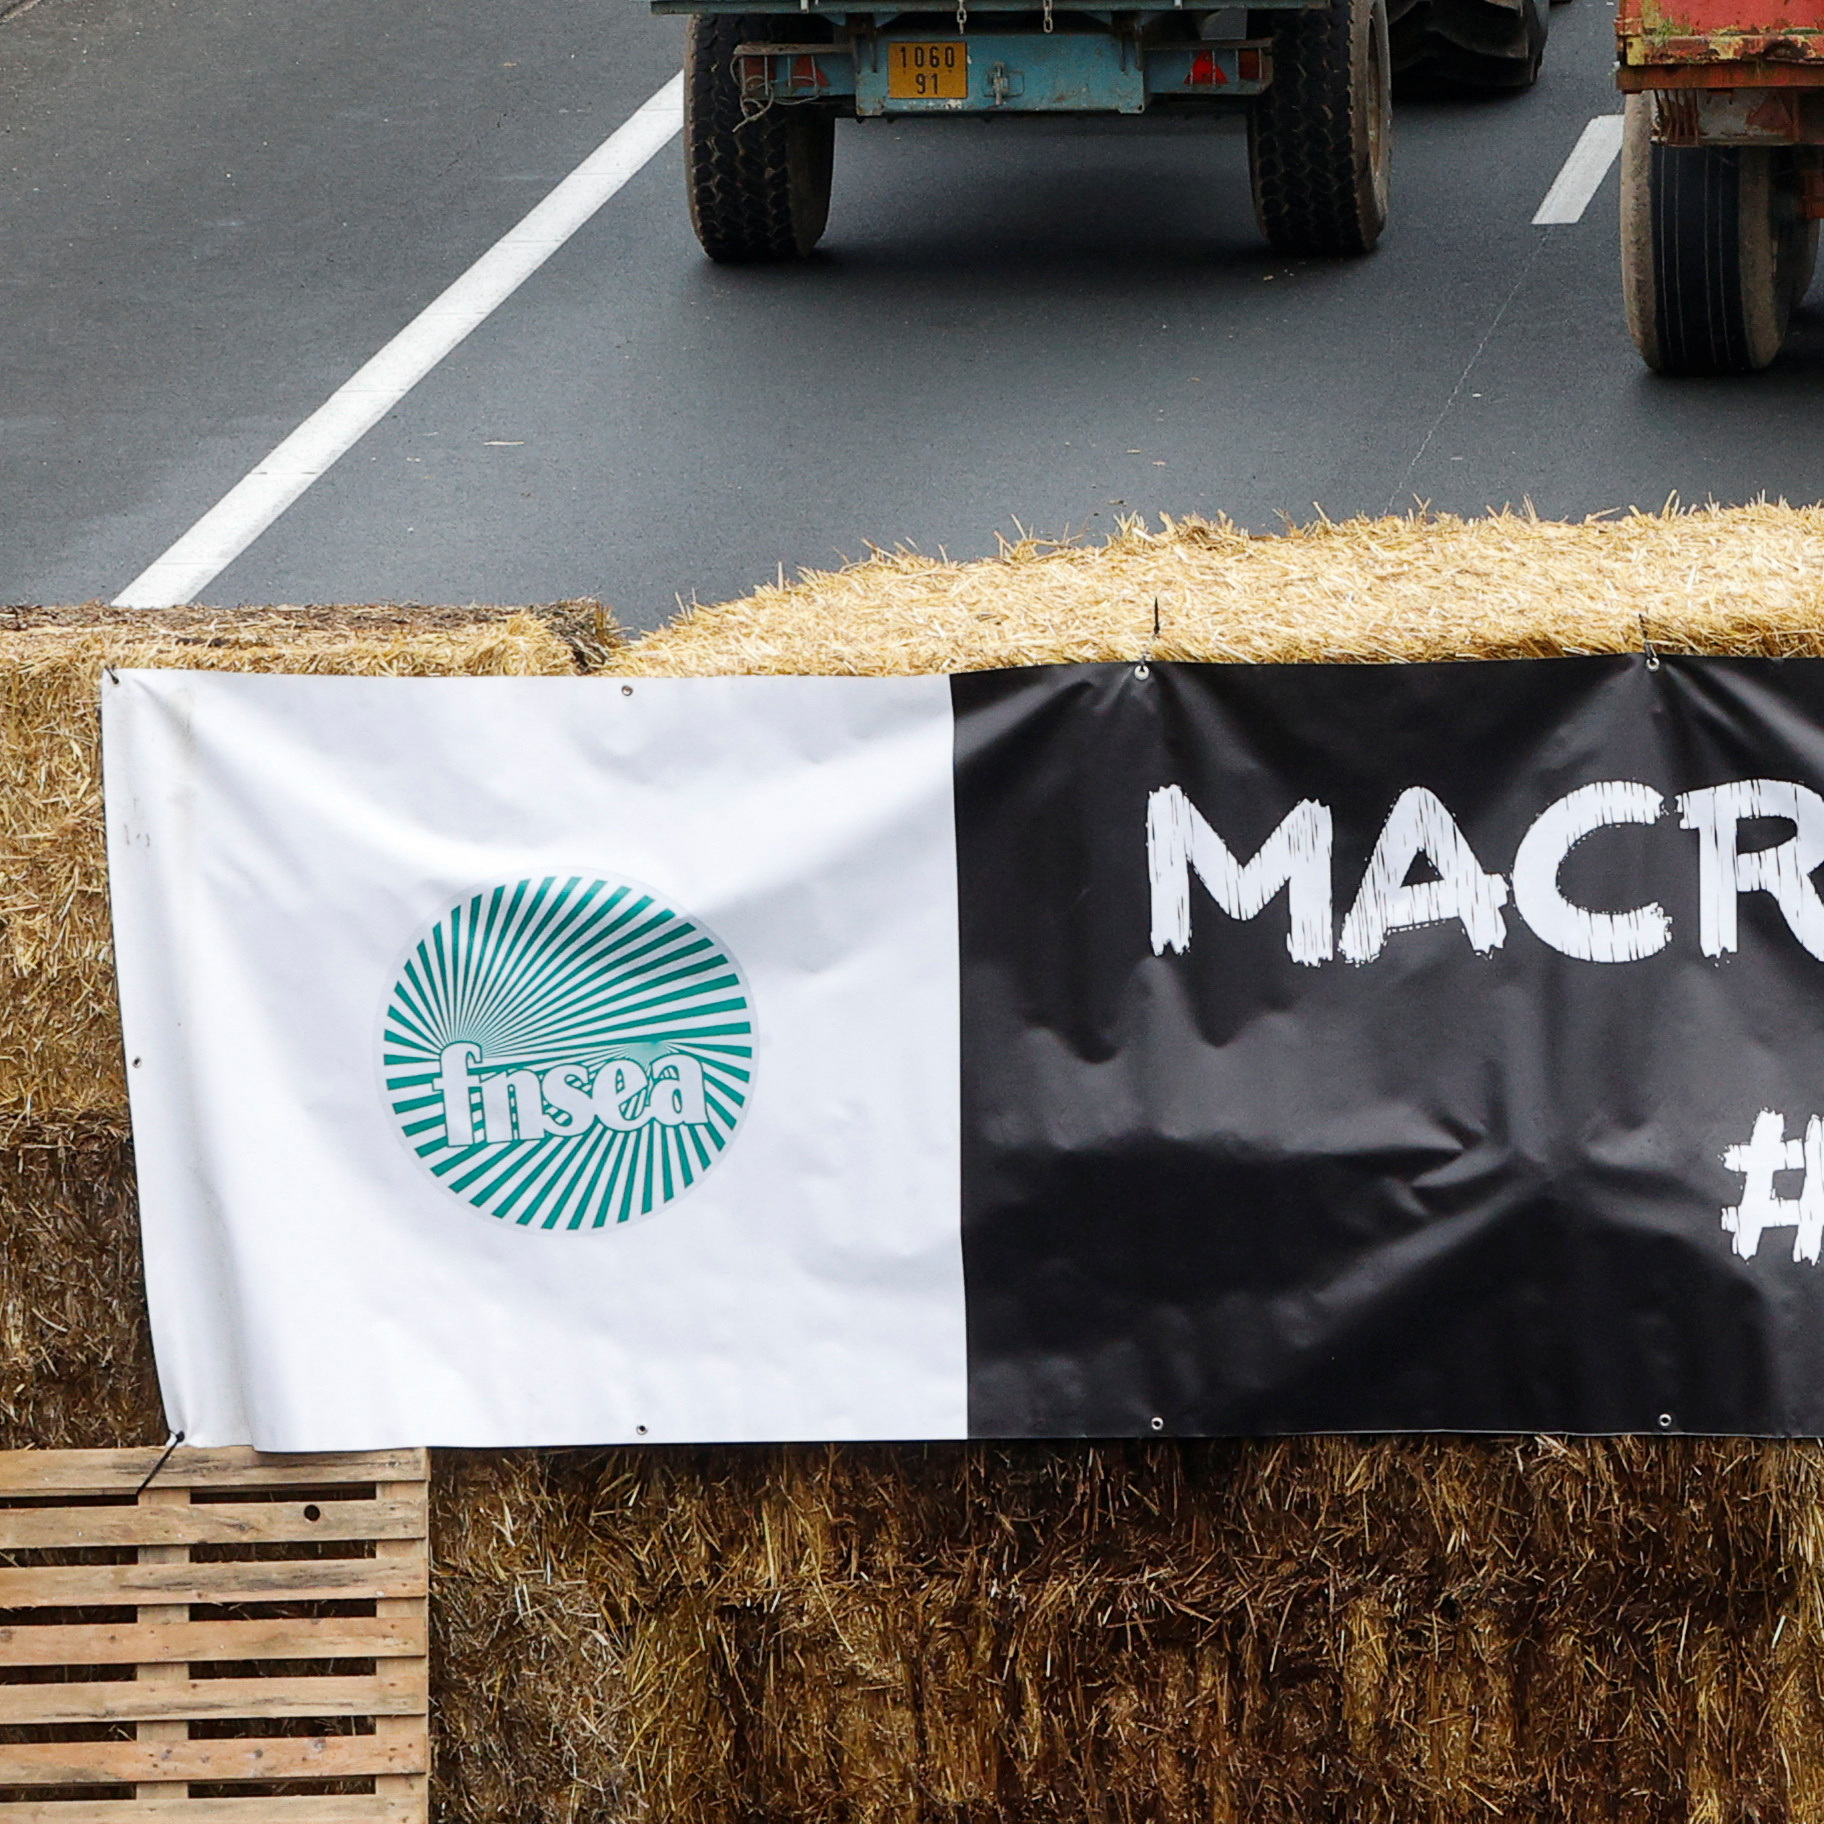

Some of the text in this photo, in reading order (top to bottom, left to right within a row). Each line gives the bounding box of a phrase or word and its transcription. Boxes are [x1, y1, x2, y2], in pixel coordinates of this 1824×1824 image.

[901, 46, 954, 68] 1060
[915, 73, 938, 95] 91
[432, 1040, 709, 1148] fnsea
